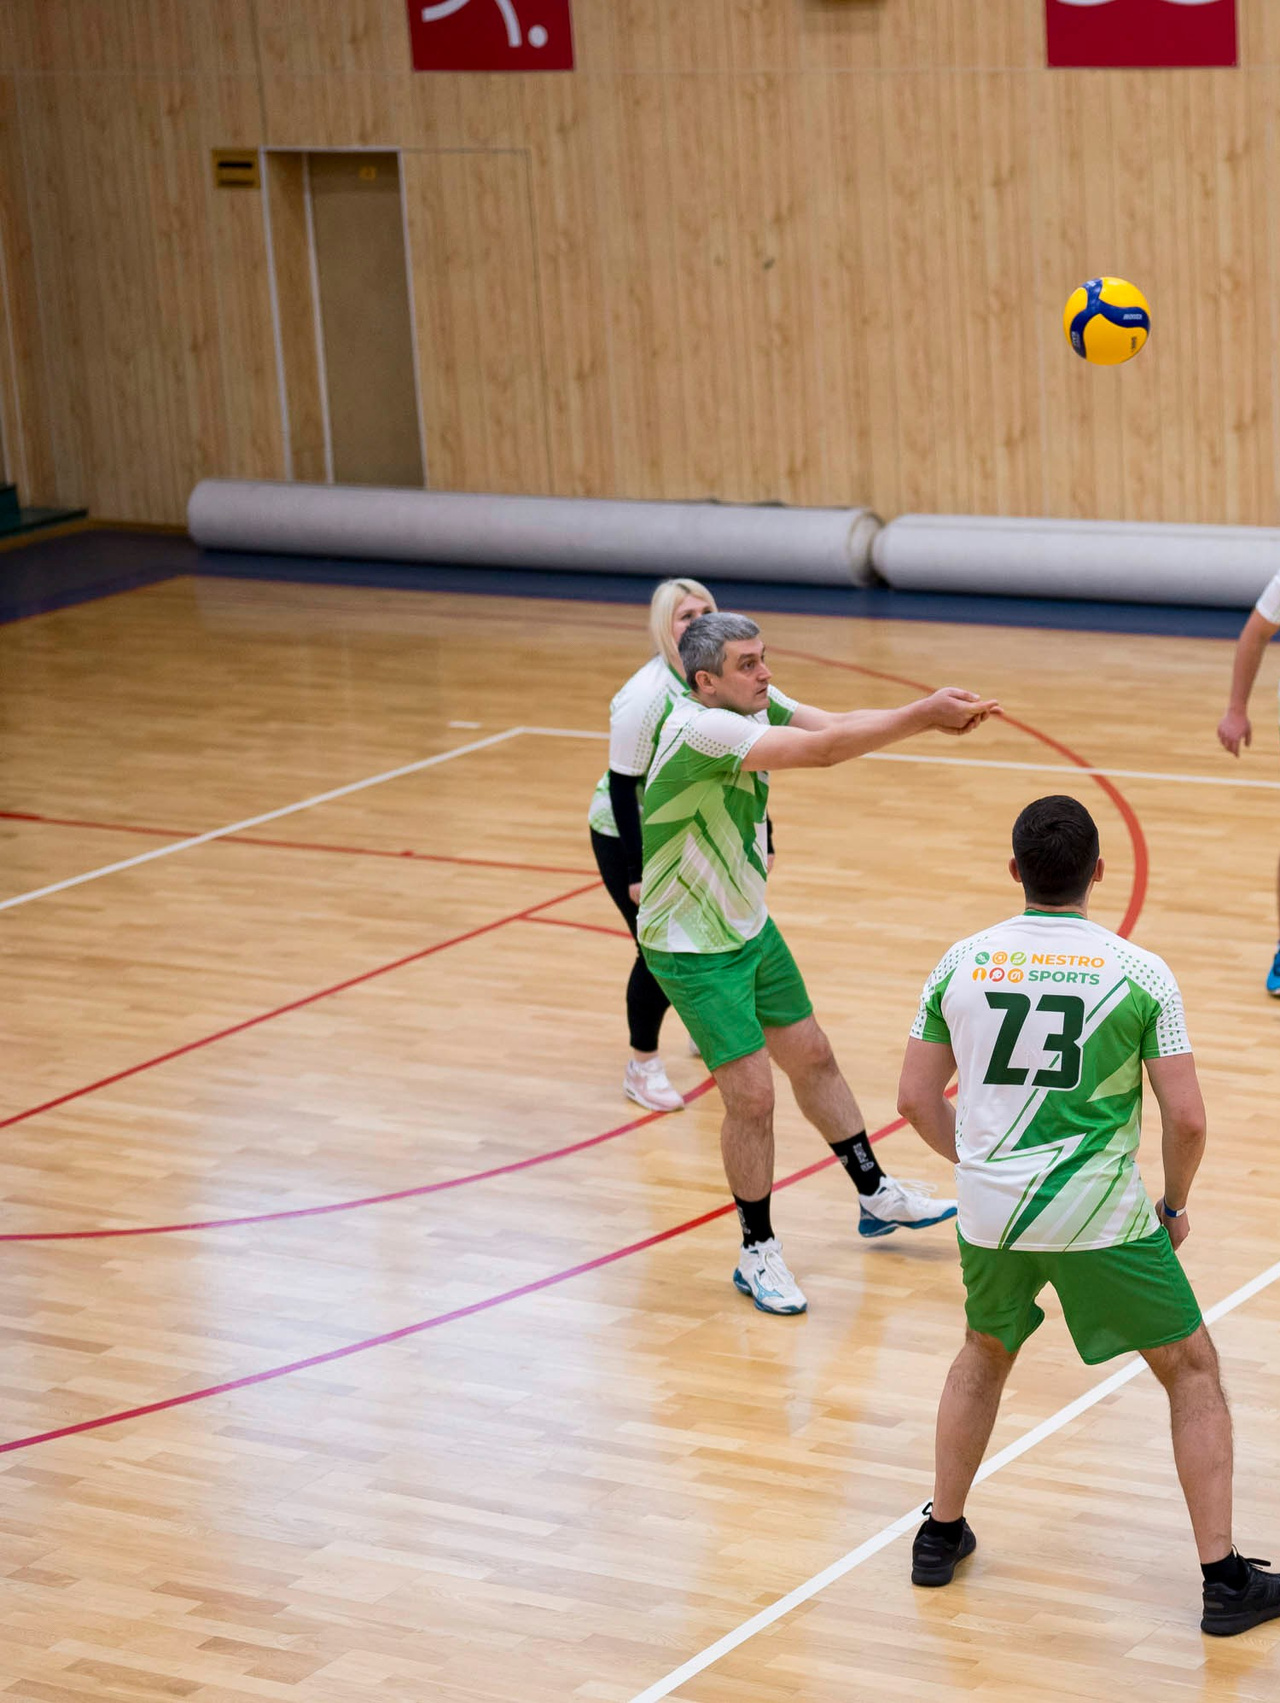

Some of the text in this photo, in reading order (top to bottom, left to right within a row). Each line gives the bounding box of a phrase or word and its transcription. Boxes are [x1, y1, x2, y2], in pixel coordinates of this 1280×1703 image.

[1031, 953, 1105, 968] NESTRO
[1028, 970, 1100, 985] SPORTS
[983, 991, 1084, 1089] 23
